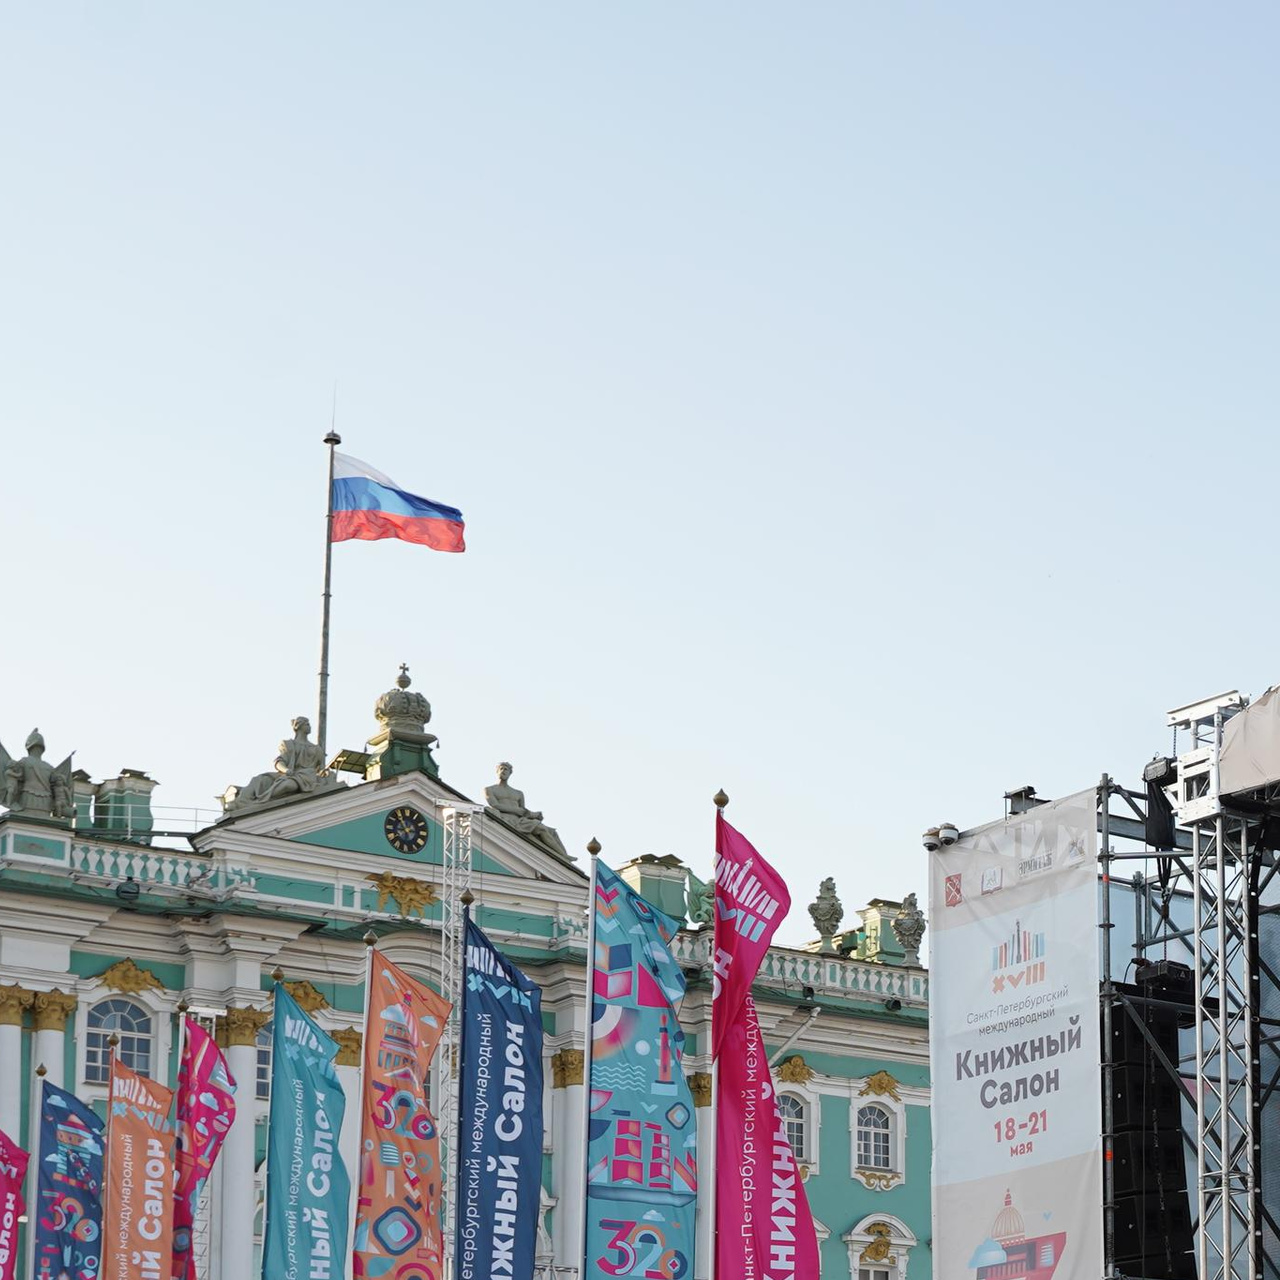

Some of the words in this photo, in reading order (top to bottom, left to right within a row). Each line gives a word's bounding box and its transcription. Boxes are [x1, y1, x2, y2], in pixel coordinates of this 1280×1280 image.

[744, 991, 761, 1082] междуна
[956, 1014, 1082, 1081] Книжный
[966, 985, 1069, 1025] Санкт-Петербургский
[978, 1008, 1055, 1037] международный
[470, 1013, 493, 1153] международный
[494, 1020, 526, 1142] Салон
[980, 1068, 1060, 1110] Салон
[285, 1079, 304, 1206] международный
[1010, 1141, 1033, 1158] мая
[118, 1134, 134, 1249] международный
[137, 1139, 166, 1241] Салон
